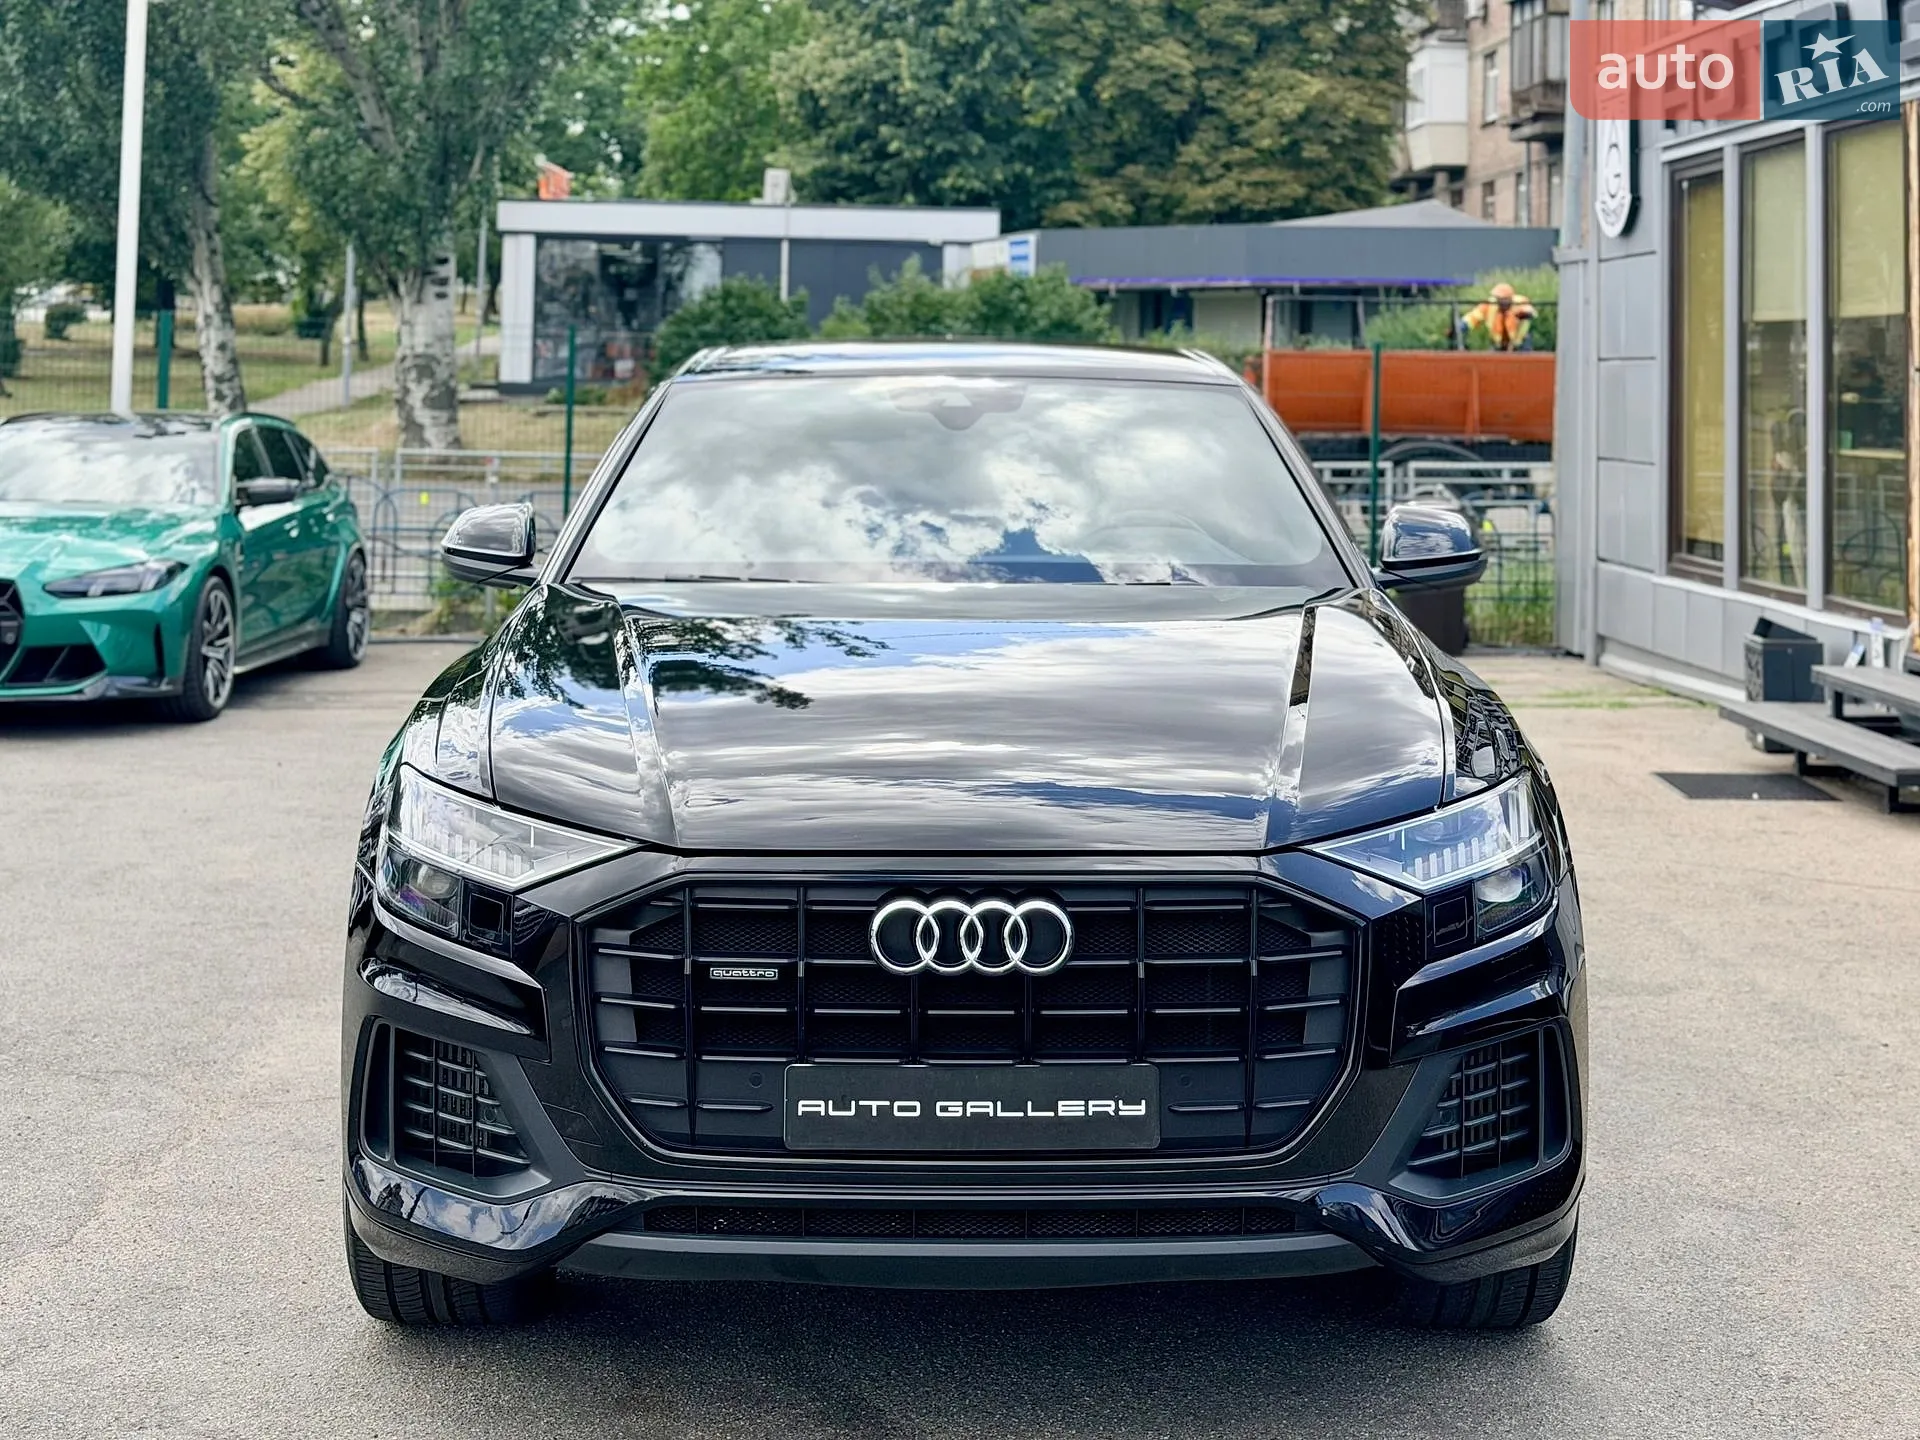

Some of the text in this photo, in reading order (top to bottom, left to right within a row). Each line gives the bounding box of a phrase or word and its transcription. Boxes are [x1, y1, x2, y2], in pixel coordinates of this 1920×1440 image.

[712, 969, 775, 979] quattro
[797, 1099, 1146, 1117] AUTO GALLERY
